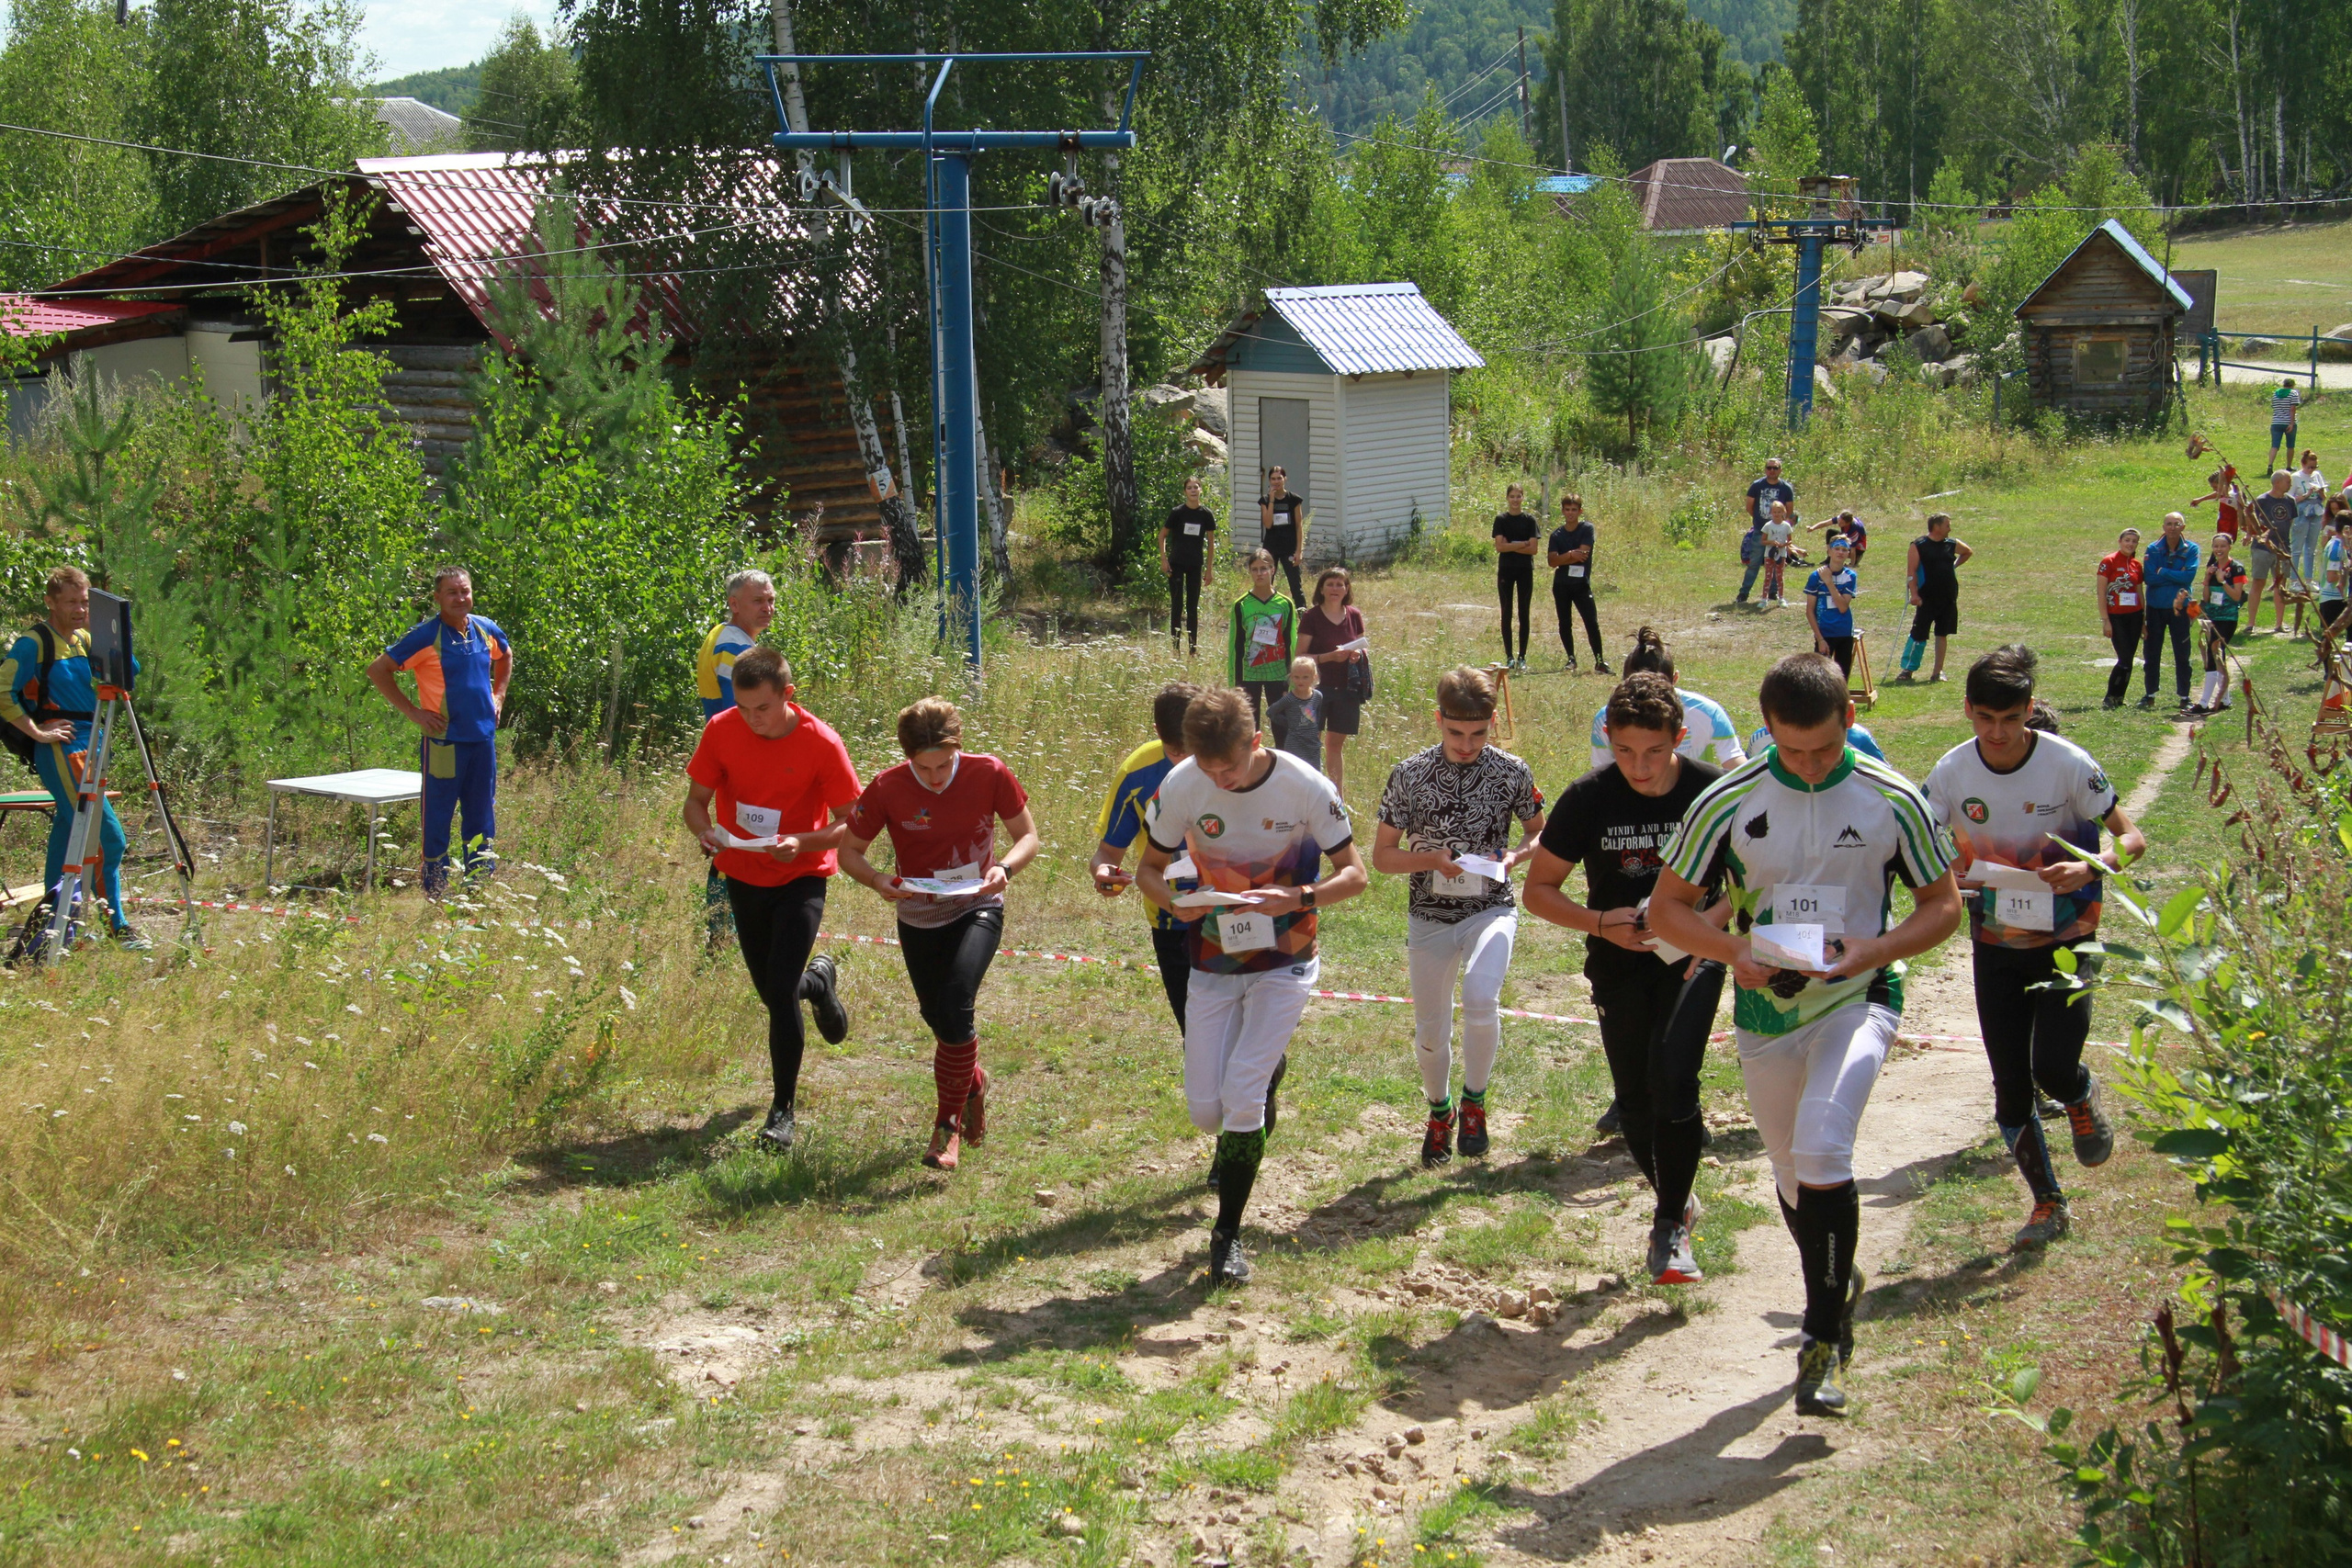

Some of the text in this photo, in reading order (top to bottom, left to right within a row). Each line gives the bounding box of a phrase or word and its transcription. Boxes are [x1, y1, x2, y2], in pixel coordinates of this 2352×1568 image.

[746, 813, 764, 823] 109
[1607, 826, 1635, 836] WINDY
[1641, 823, 1659, 834] AND
[1601, 834, 1654, 851] CALIFORNIA
[1791, 898, 1817, 912] 101
[2010, 898, 2030, 909] 111
[1230, 921, 1251, 934] 104
